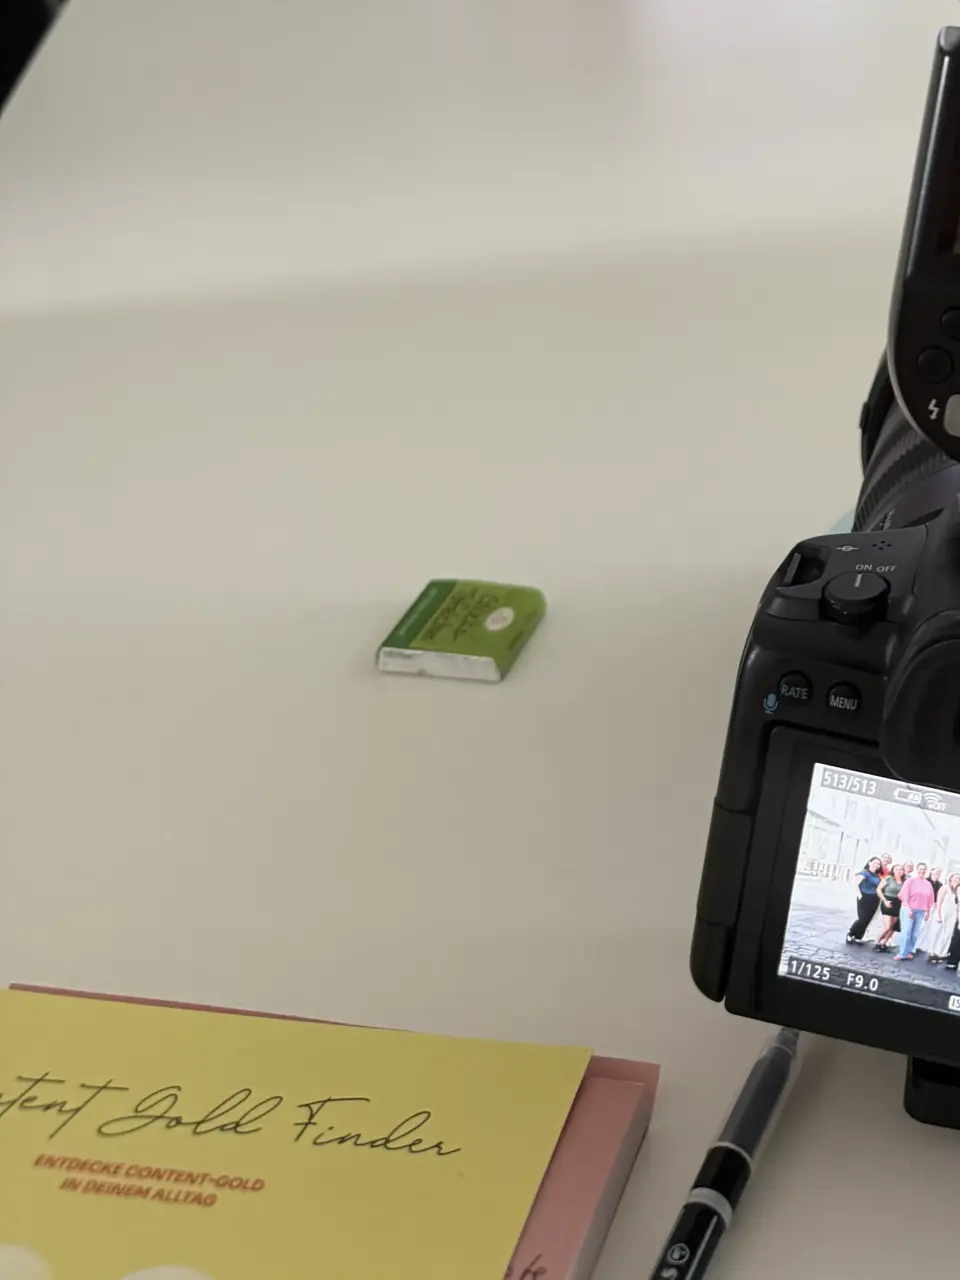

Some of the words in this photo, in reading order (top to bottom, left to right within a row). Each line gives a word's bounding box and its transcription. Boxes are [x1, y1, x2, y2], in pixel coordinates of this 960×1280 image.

[855, 563, 873, 571] ON
[876, 565, 897, 573] OFF
[780, 684, 809, 700] RATE
[830, 695, 858, 711] MENU
[822, 770, 877, 795] 513/513
[790, 960, 831, 981] 1/125
[846, 972, 879, 991] F9.0
[0, 1070, 130, 1140] tent
[97, 1085, 284, 1139] Gold
[293, 1096, 462, 1157] Finder
[34, 1153, 125, 1175] ENTDECKE
[124, 1164, 265, 1192] CONTENT-GOLD
[59, 1177, 79, 1191] IN
[82, 1179, 151, 1200] DEINEM
[151, 1188, 218, 1208] ALLTAG
